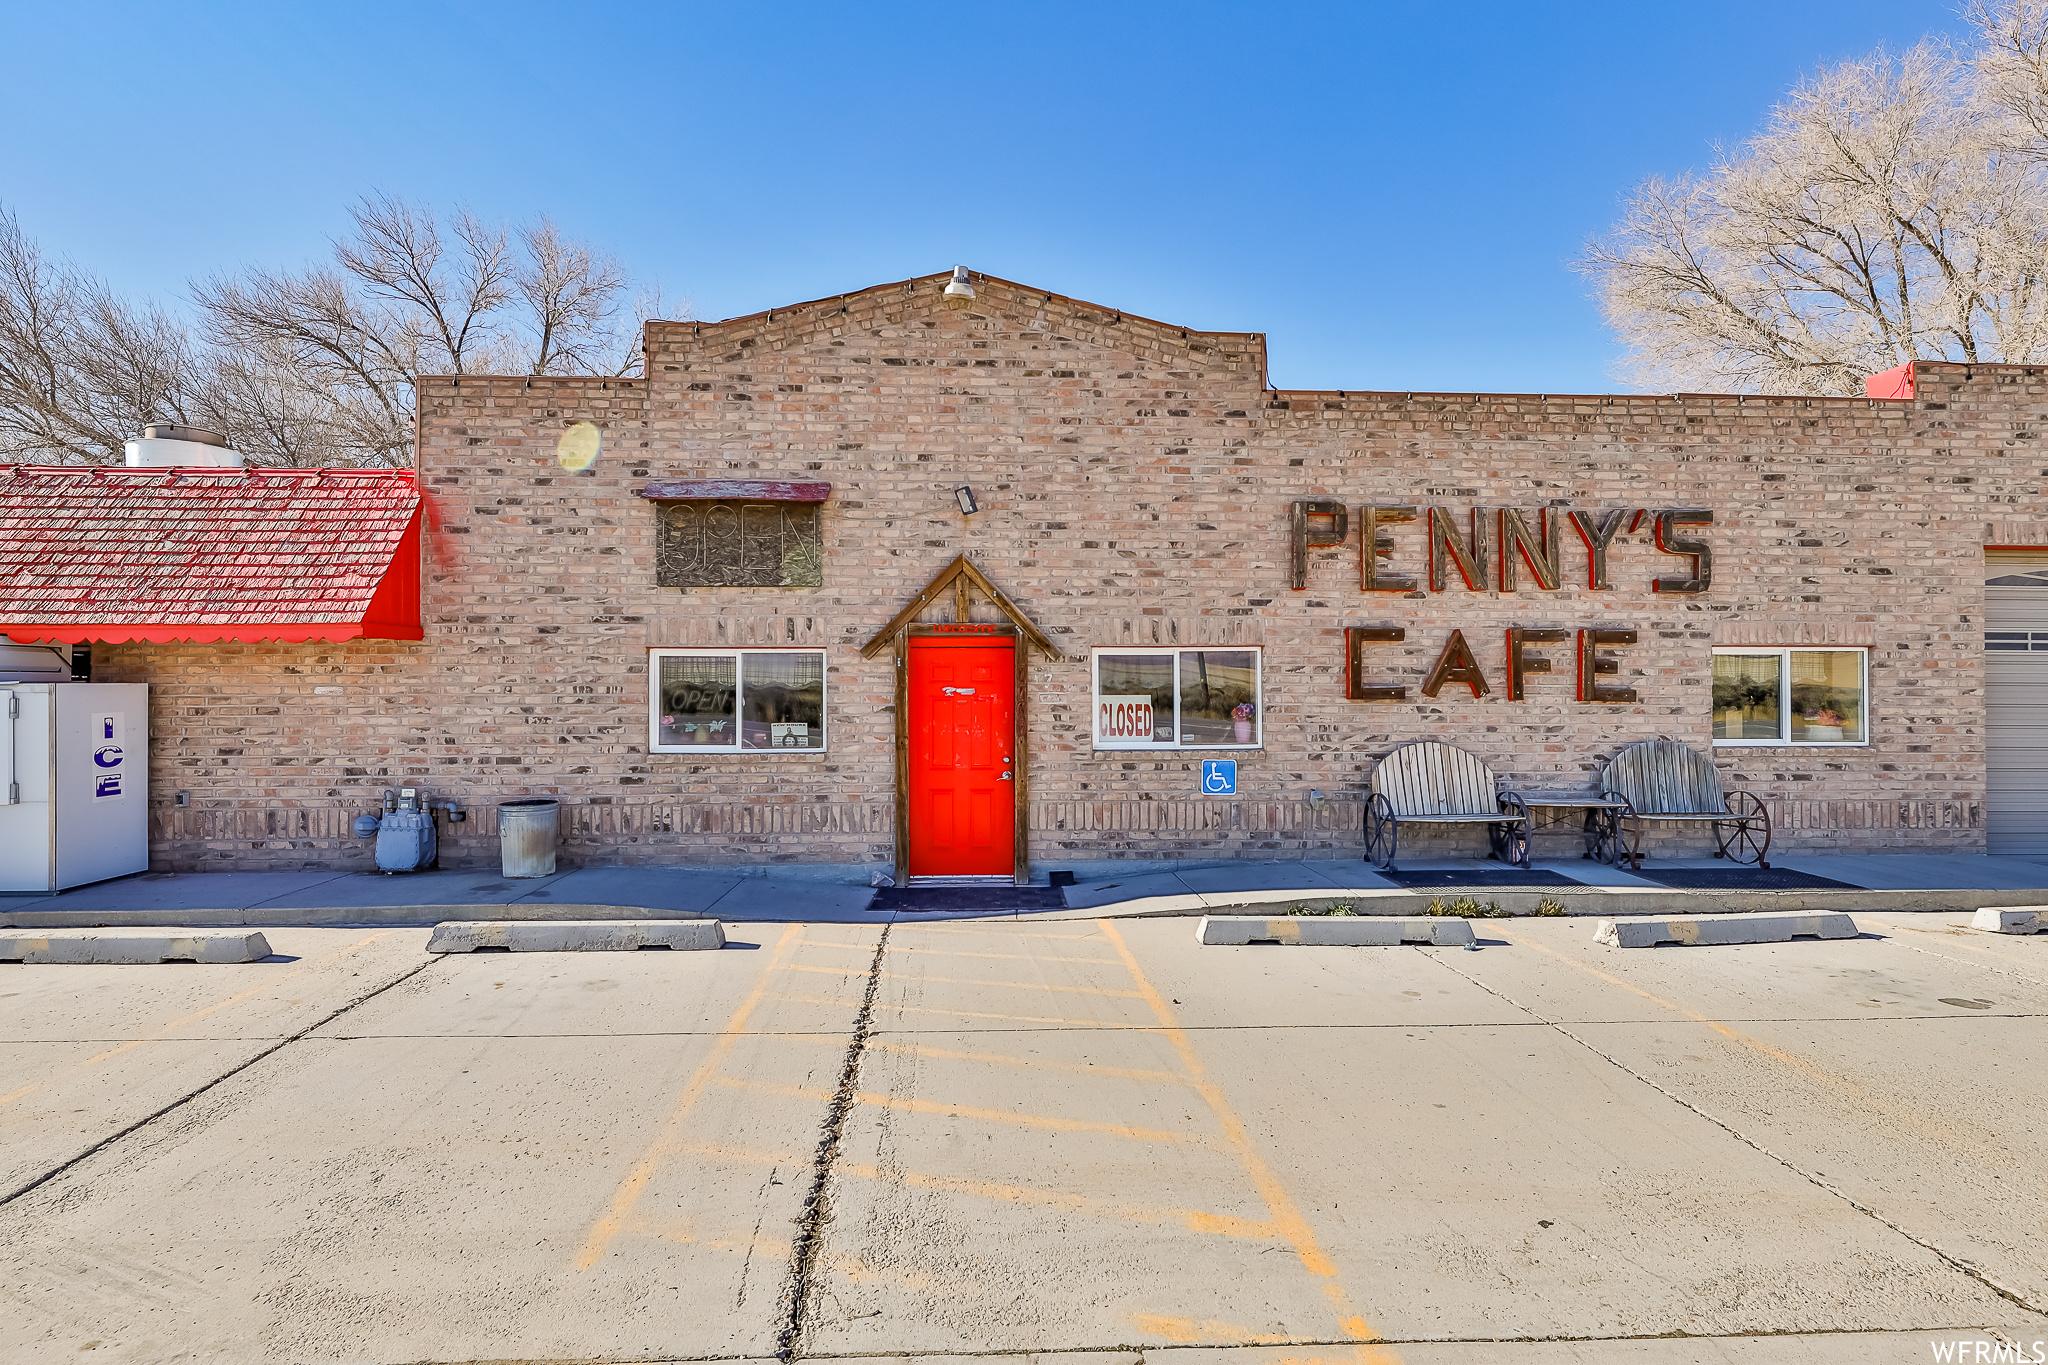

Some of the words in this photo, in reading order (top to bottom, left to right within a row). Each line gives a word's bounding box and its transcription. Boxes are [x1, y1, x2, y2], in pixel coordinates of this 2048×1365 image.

[662, 504, 816, 571] OPEN
[1291, 501, 1713, 593] PENNY'S
[1345, 626, 1637, 702] CAFE
[671, 689, 729, 711] OPEN
[1100, 702, 1151, 737] CLOSED
[93, 717, 124, 798] ICE
